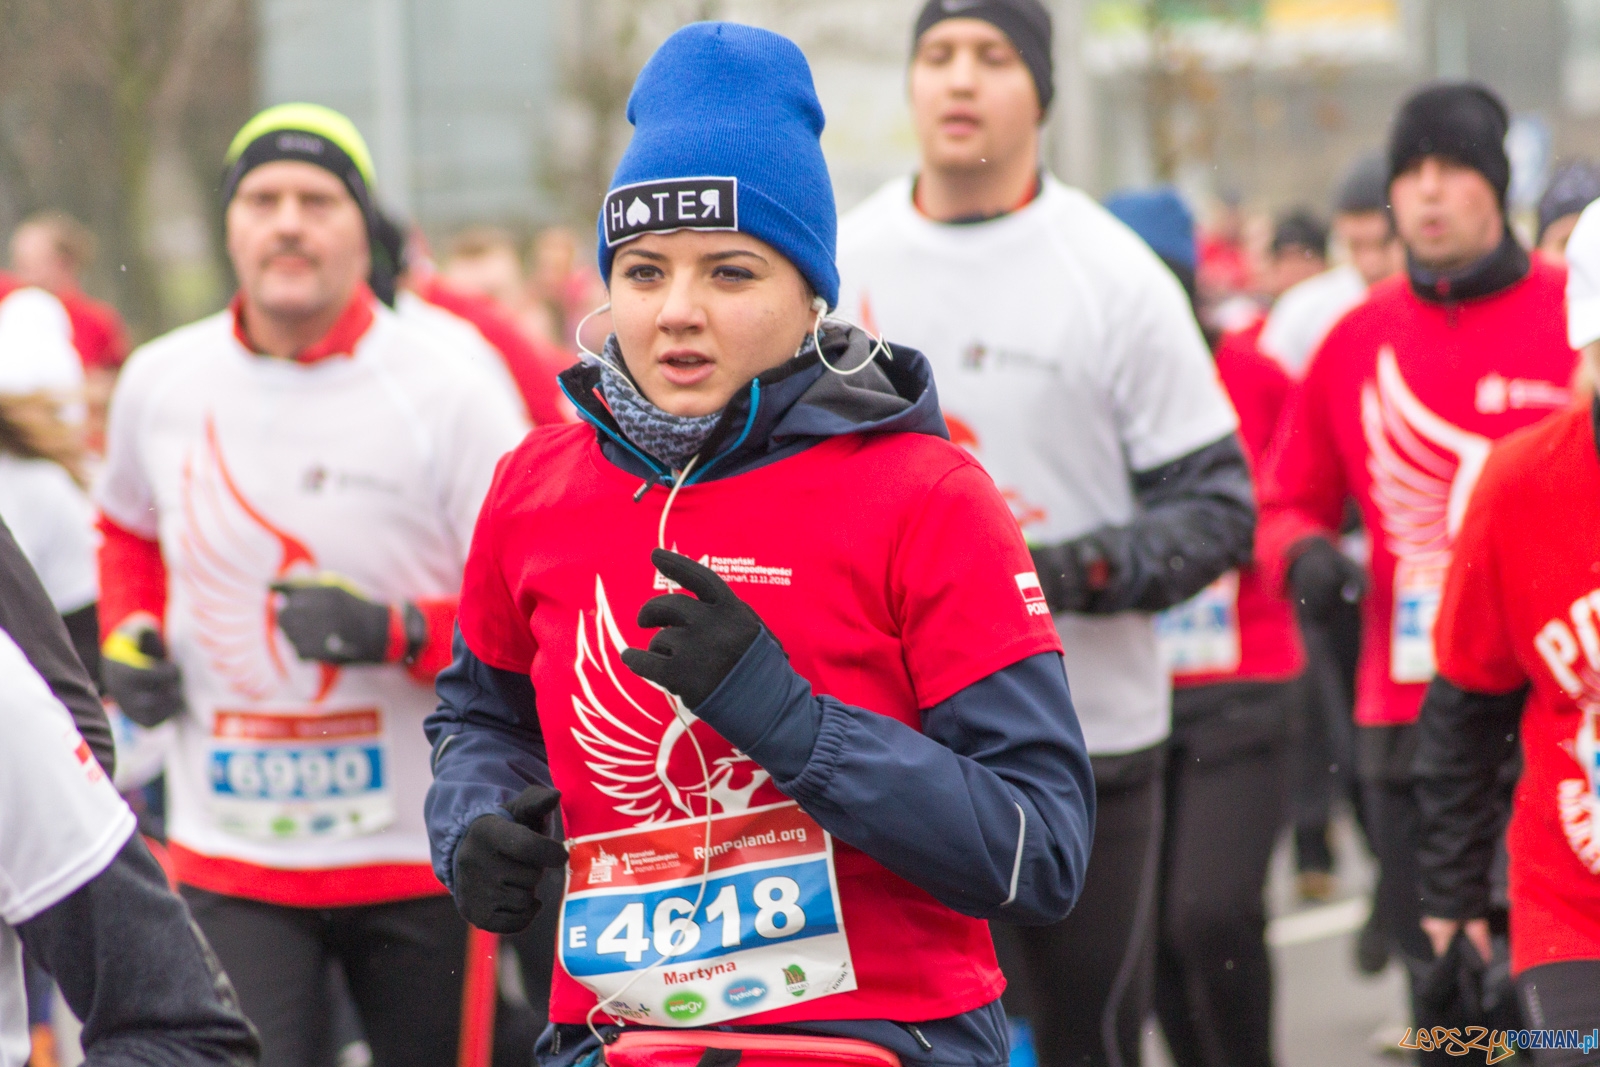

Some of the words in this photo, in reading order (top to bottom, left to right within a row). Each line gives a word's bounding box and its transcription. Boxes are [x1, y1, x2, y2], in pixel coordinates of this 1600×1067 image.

[228, 749, 371, 797] 6990
[693, 828, 807, 860] RunPoland.org
[569, 925, 587, 948] E
[596, 876, 806, 963] 4618
[664, 961, 737, 985] Martyna
